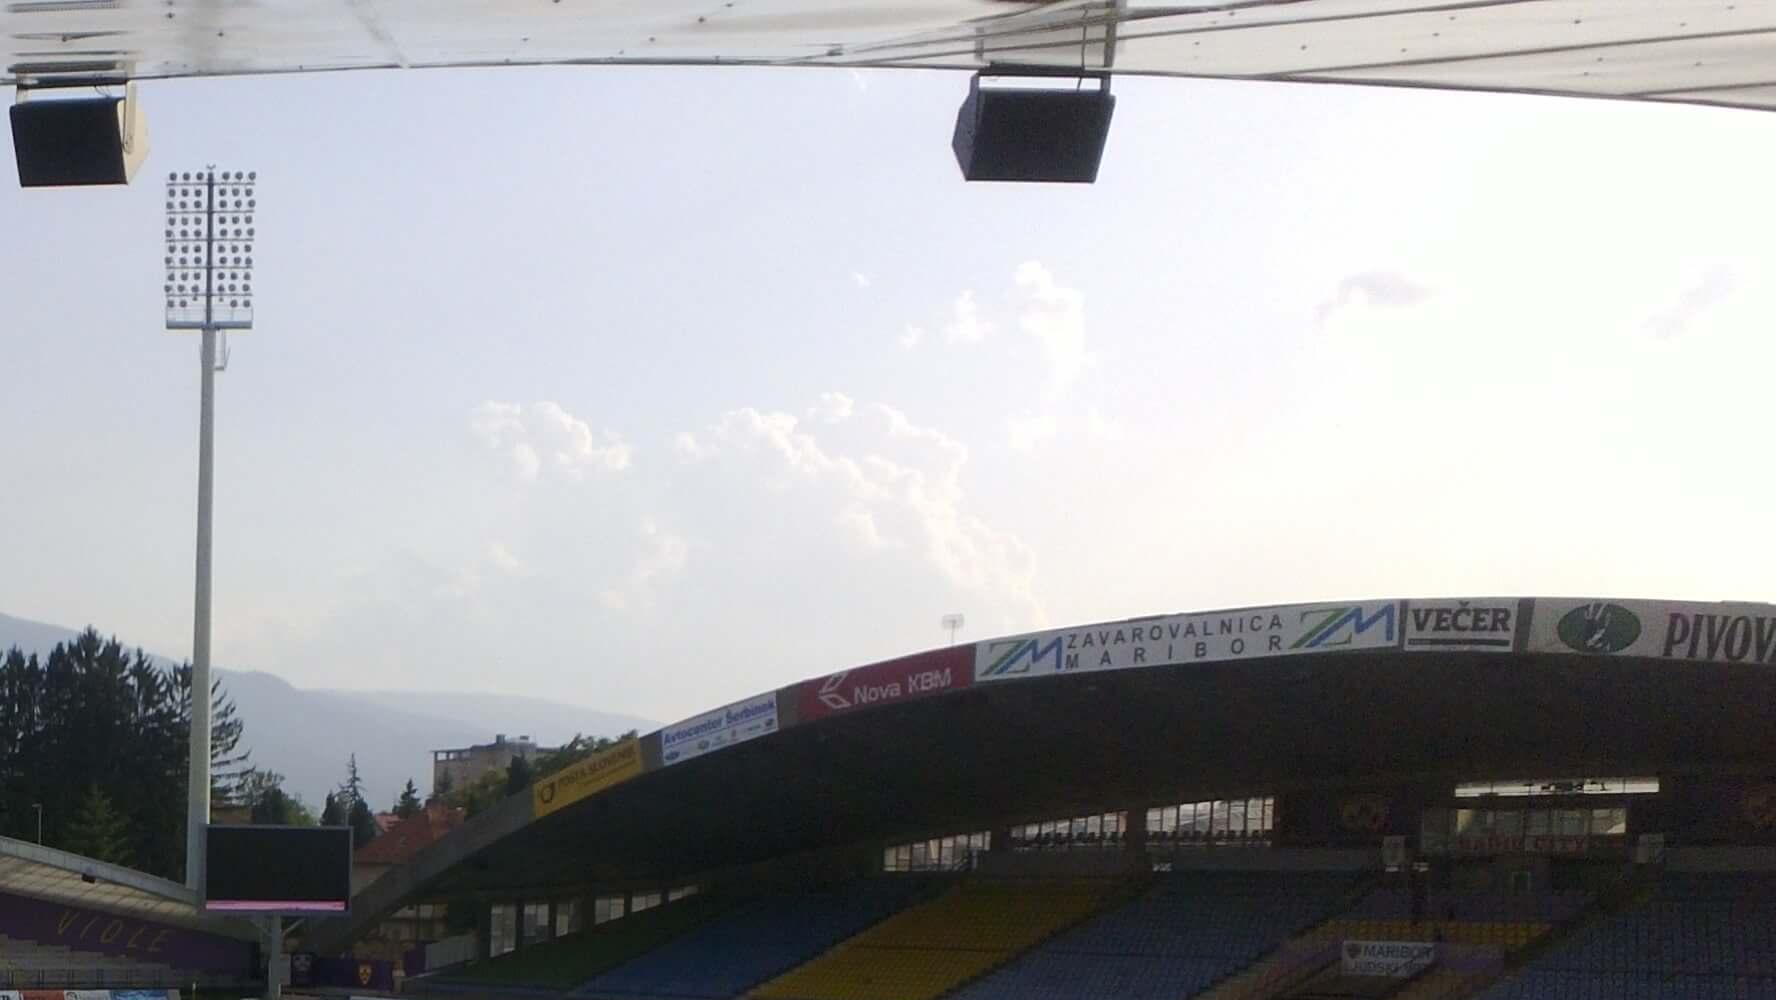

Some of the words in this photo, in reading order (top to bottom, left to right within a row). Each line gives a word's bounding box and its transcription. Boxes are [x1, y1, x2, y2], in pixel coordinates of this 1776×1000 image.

[1067, 614, 1283, 650] ZAVAROVALNICA
[1411, 601, 1512, 632] VEČER
[1065, 636, 1282, 669] MARIBOR
[1663, 612, 1776, 663] PIVOV
[854, 681, 901, 704] Nova
[908, 668, 952, 693] KBM
[664, 718, 723, 747] Avtocenter
